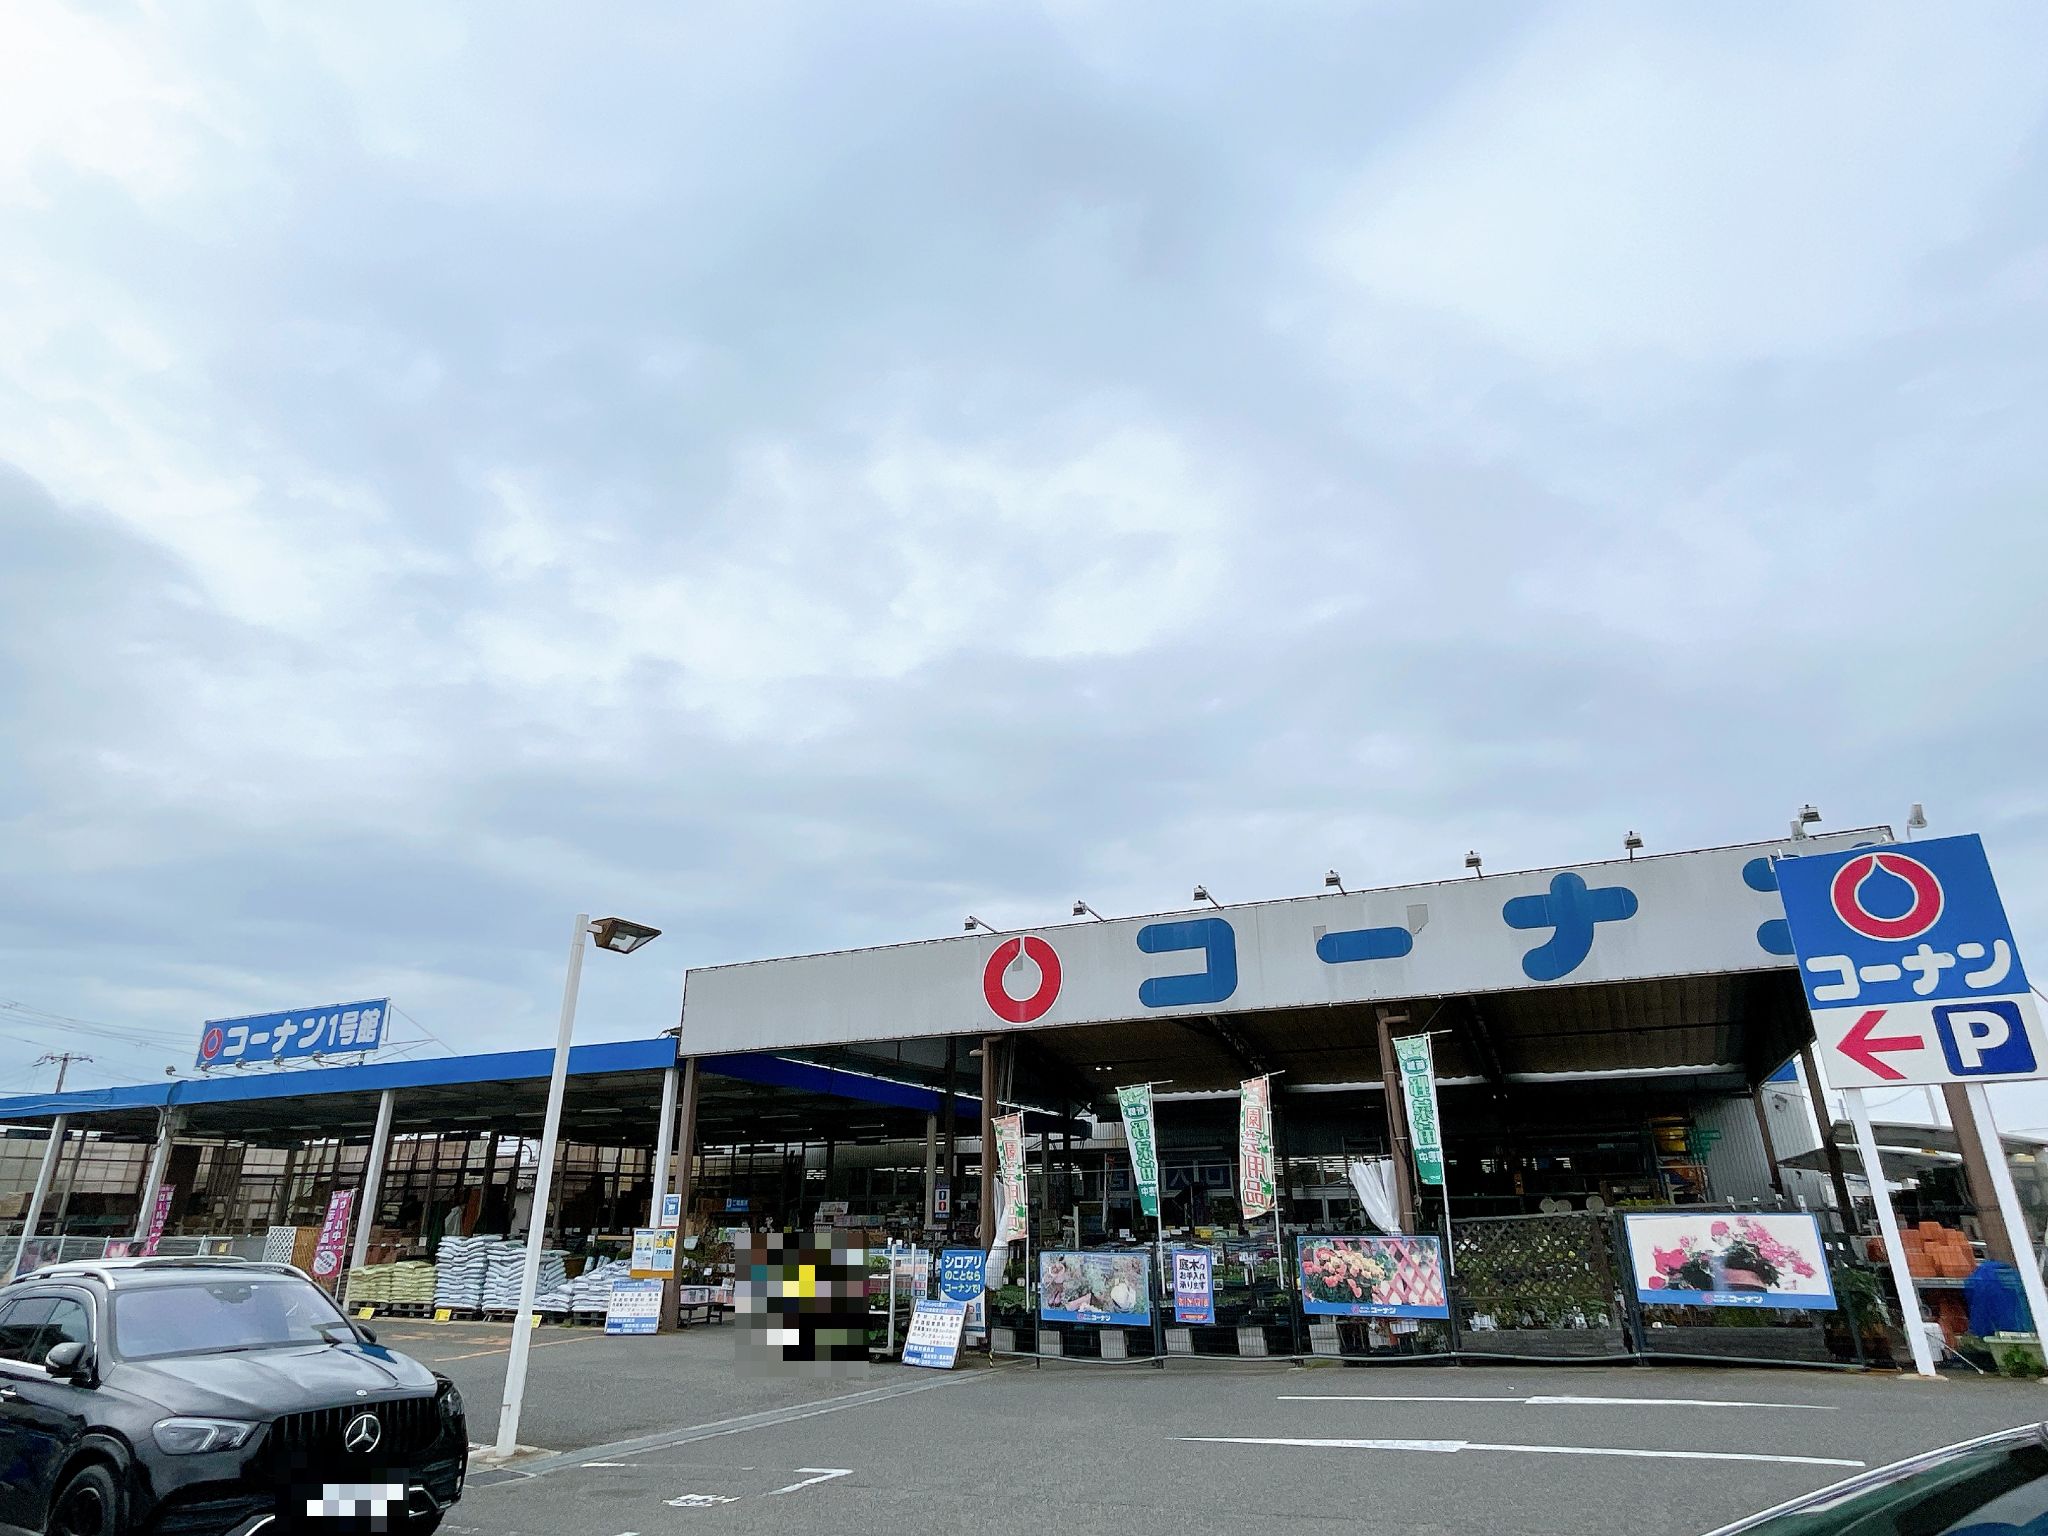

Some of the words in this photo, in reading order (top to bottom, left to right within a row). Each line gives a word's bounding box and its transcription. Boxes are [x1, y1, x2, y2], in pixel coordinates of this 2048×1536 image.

[1805, 939, 2012, 1002] コーナン
[223, 1007, 381, 1058] コーナン1号館
[1946, 1009, 2011, 1069] P
[944, 1255, 982, 1270] シロアリ
[1178, 1258, 1206, 1271] 庭木の
[944, 1271, 981, 1281] のことなら
[1179, 1271, 1206, 1281] お手入れ
[1179, 1281, 1206, 1290] 承ります
[1370, 1306, 1397, 1315] コーナン
